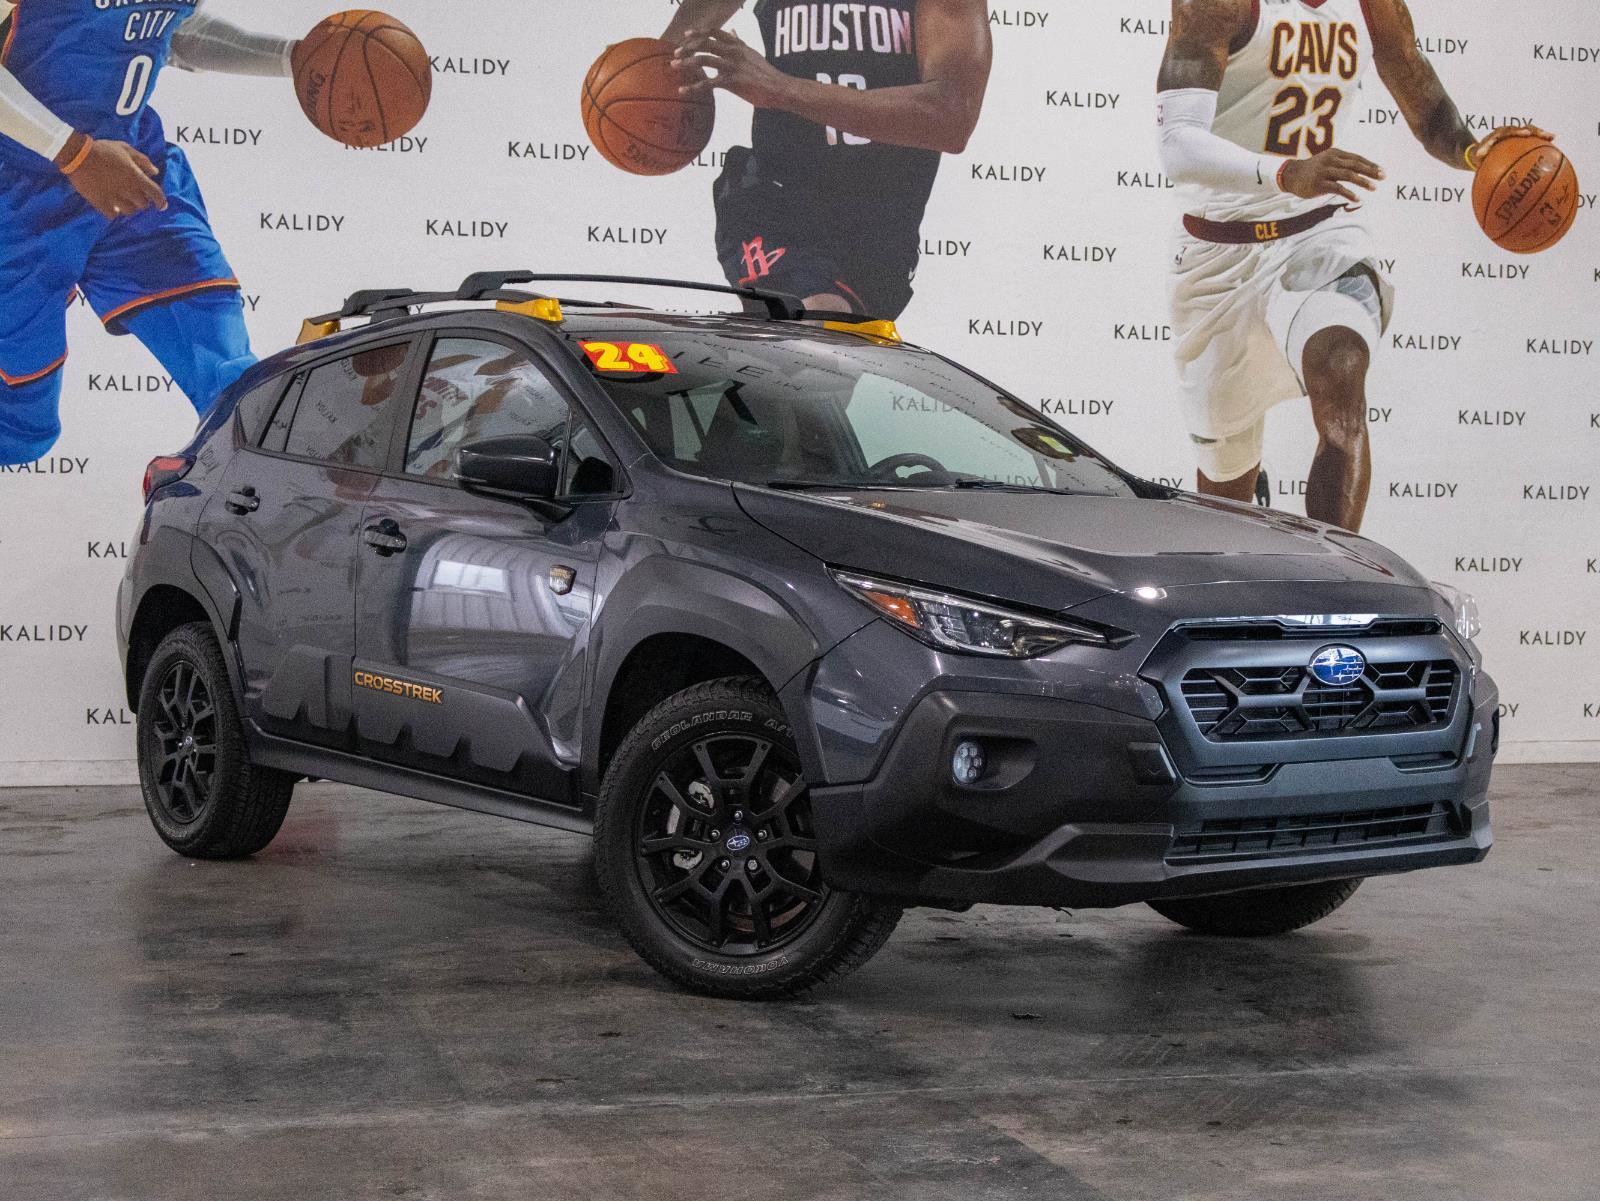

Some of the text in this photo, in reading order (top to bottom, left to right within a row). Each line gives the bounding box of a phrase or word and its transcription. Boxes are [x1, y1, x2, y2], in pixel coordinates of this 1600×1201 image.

[124, 9, 177, 41] CITY
[988, 9, 1049, 28] ALIDY
[1120, 17, 1172, 36] KALI
[775, 4, 912, 57] HOUSTON
[1267, 20, 1359, 81] CAVS
[1414, 37, 1468, 55] ALIDY
[1533, 44, 1600, 63] KALIDY
[429, 56, 511, 76] KALIDY
[115, 55, 153, 117] 0
[1046, 90, 1120, 109] KALIDY
[1263, 84, 1343, 158] 23
[176, 126, 262, 146] KALIDY
[508, 141, 590, 161] KALIDY
[971, 164, 1046, 182] KALIDY
[1117, 171, 1174, 188] KALI
[1396, 185, 1465, 203] KALIDY
[260, 212, 345, 232] KALIDY
[426, 219, 508, 239] KALIDY
[1254, 221, 1279, 240] CLE
[588, 226, 667, 245] KALIDY
[918, 240, 971, 256] LIDY
[1043, 245, 1117, 263] KALIDY
[1462, 262, 1529, 280] KALIDY
[969, 319, 1043, 337] KALIDY
[1114, 324, 1170, 341] KALID
[1392, 334, 1462, 351] KALIDY
[1526, 339, 1593, 355] KALIDY
[88, 374, 174, 392] KALIDY
[1040, 398, 1114, 416] KALIDY
[1458, 410, 1526, 426] KALIDY
[1389, 482, 1458, 498] KALIDY
[1523, 485, 1590, 501] KALIDY
[88, 541, 128, 558] KAL
[1455, 558, 1523, 573] KALIDY
[0, 624, 88, 641] KALIDY
[1519, 630, 1586, 646] KALIDY
[354, 671, 443, 704] CROSSTREK
[87, 708, 131, 725] KAL
